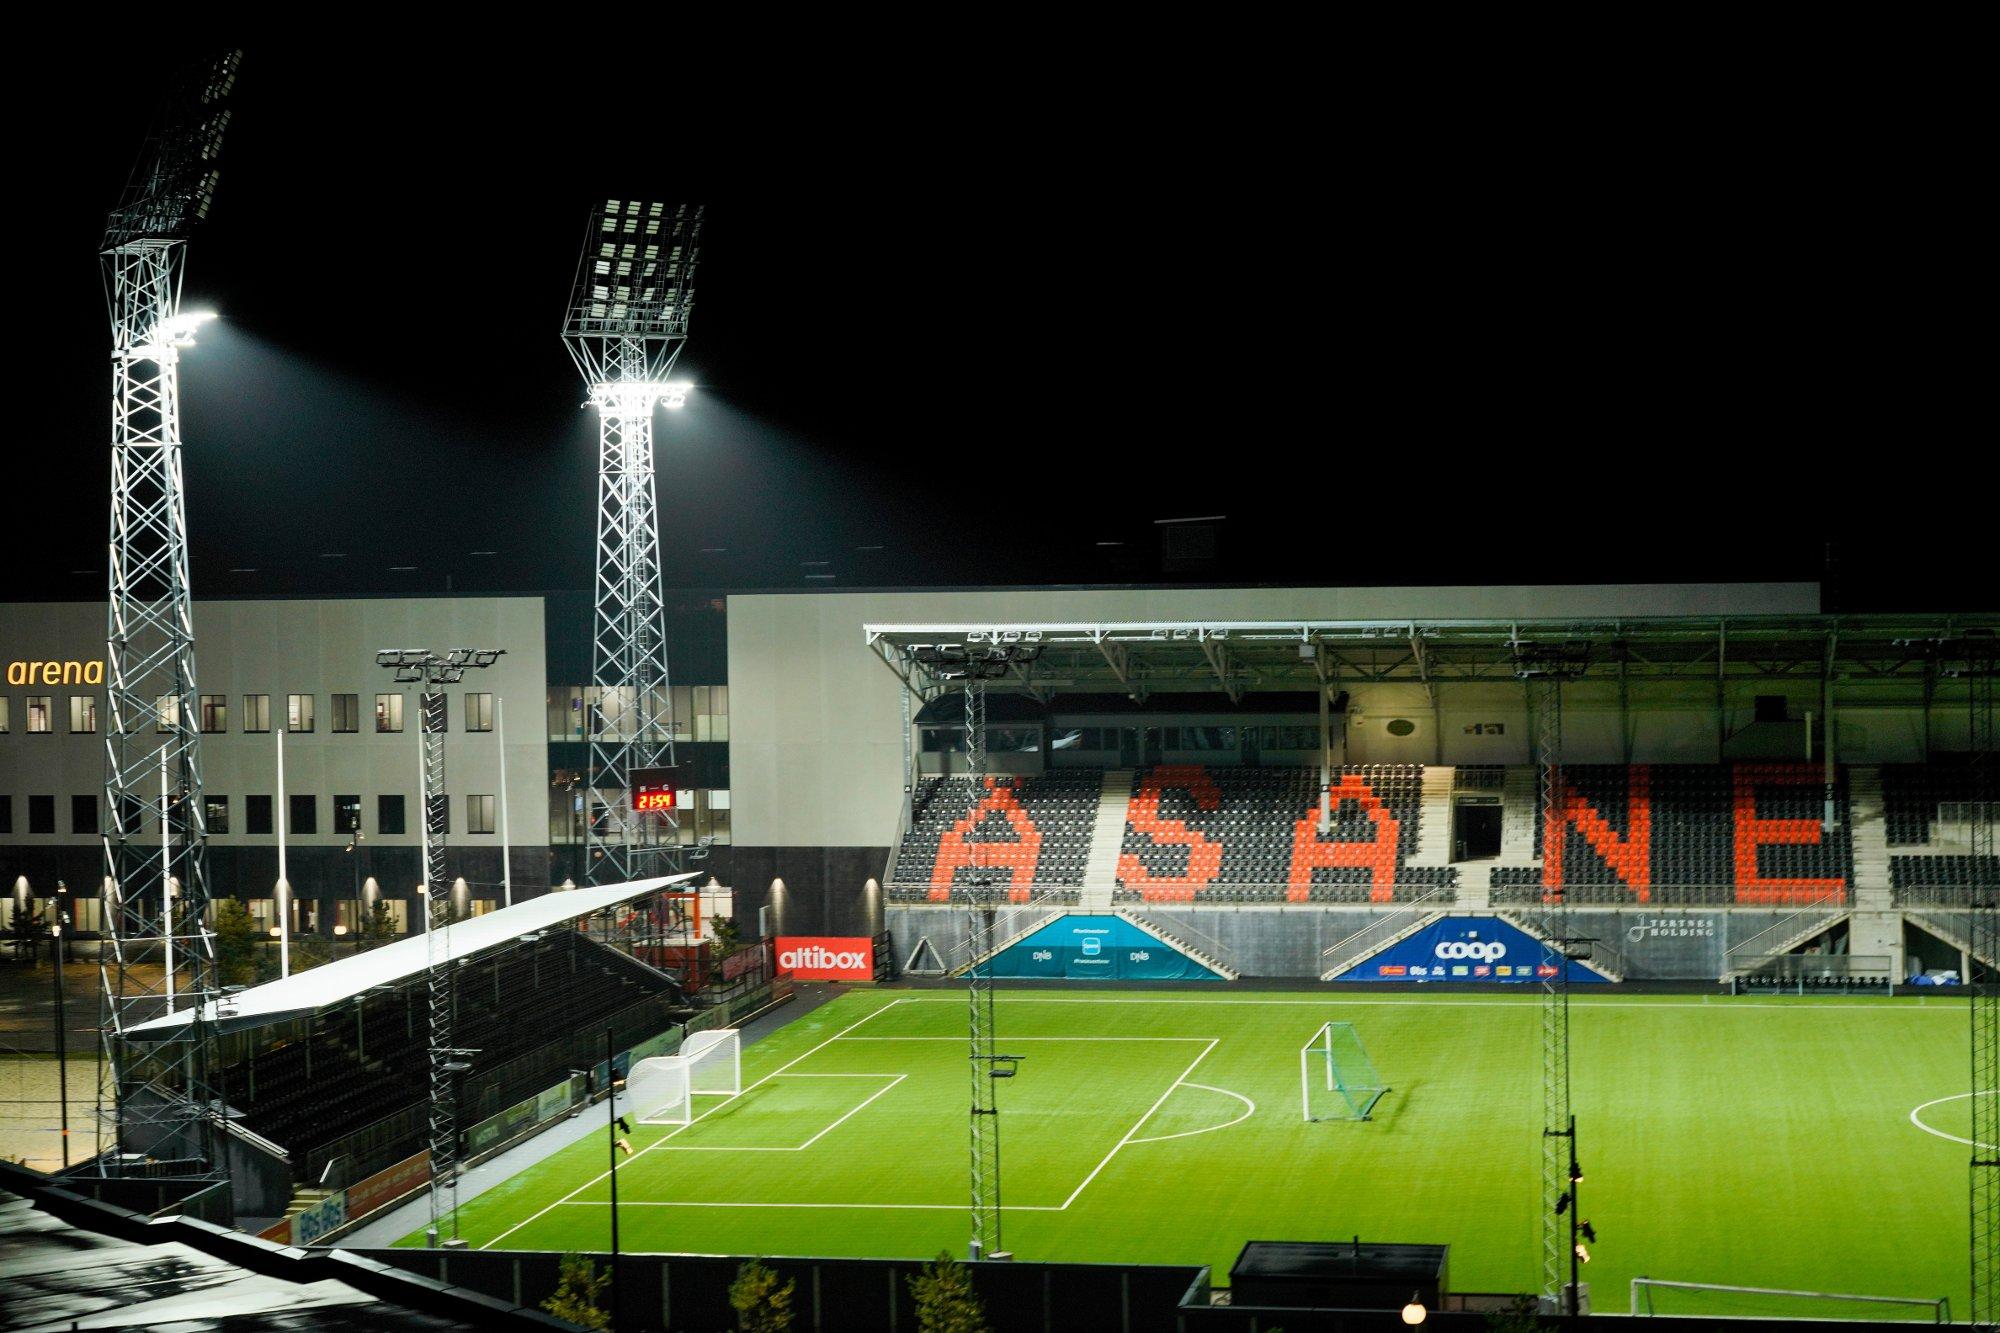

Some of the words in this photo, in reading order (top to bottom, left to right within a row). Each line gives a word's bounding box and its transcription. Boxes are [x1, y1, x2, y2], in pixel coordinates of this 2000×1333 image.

[7, 660, 104, 685] arena
[638, 794, 671, 809] 21:54
[1649, 919, 1714, 927] TERTNES
[1650, 928, 1714, 937] HOLDING
[779, 945, 867, 970] altibox
[1129, 950, 1150, 963] DNB
[1435, 941, 1507, 963] coop
